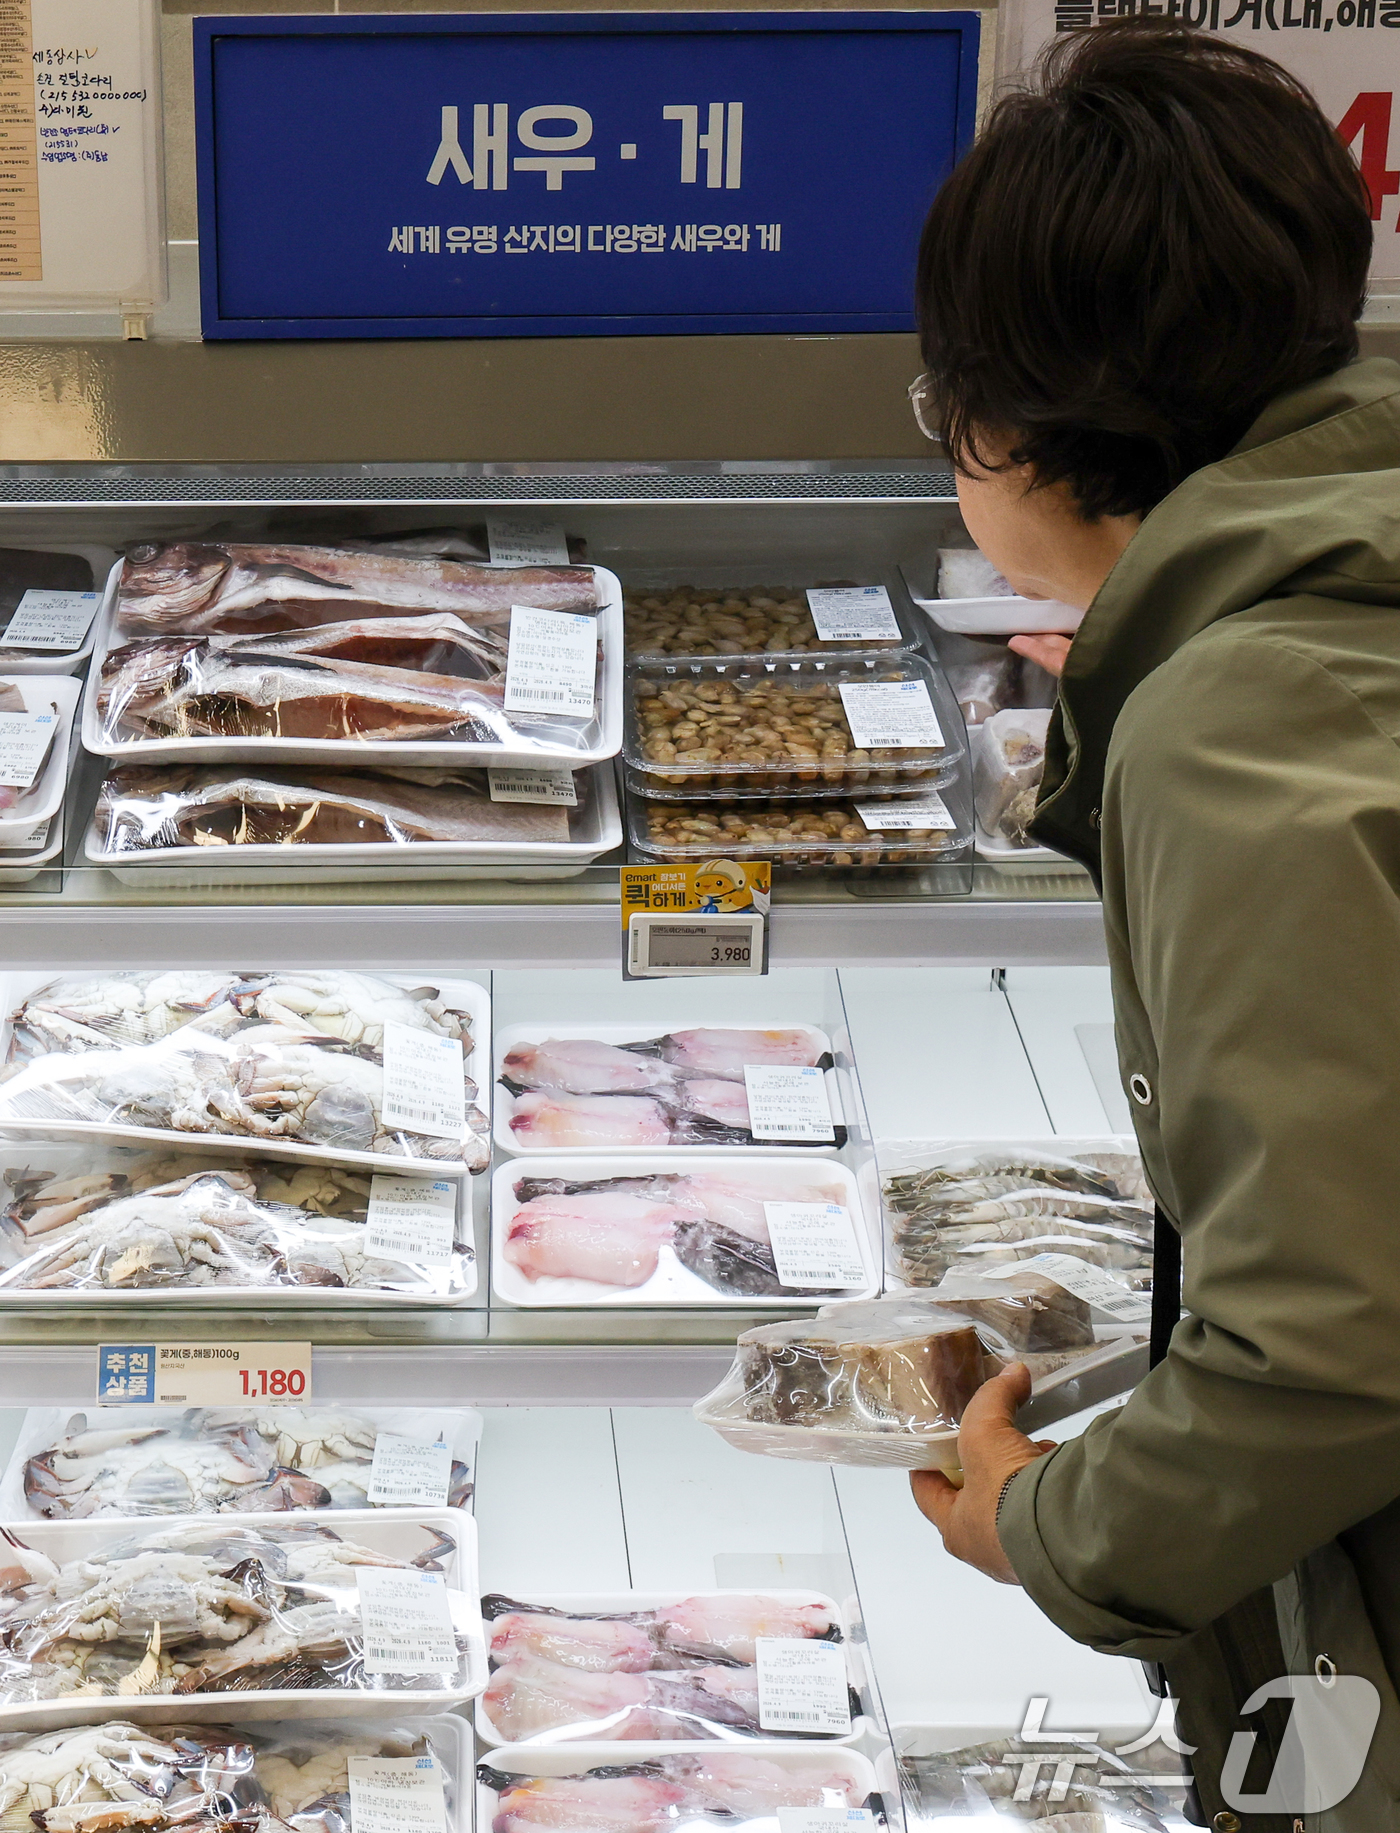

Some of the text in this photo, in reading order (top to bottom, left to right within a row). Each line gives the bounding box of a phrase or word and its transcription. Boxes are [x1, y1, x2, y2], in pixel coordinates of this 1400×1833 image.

[425, 103, 596, 191] 새우
[662, 102, 743, 189] 게
[388, 223, 781, 254] 세계 유명 산지의 다양한 새우와 게
[625, 873, 656, 882] emart
[440, 1119, 462, 1128] 13227
[106, 1352, 149, 1374] 추천
[160, 1348, 240, 1361] 꽃게(중,해동)100g
[105, 1375, 149, 1397] 상품
[239, 1369, 306, 1398] 1,180
[425, 1491, 445, 1499] 10738
